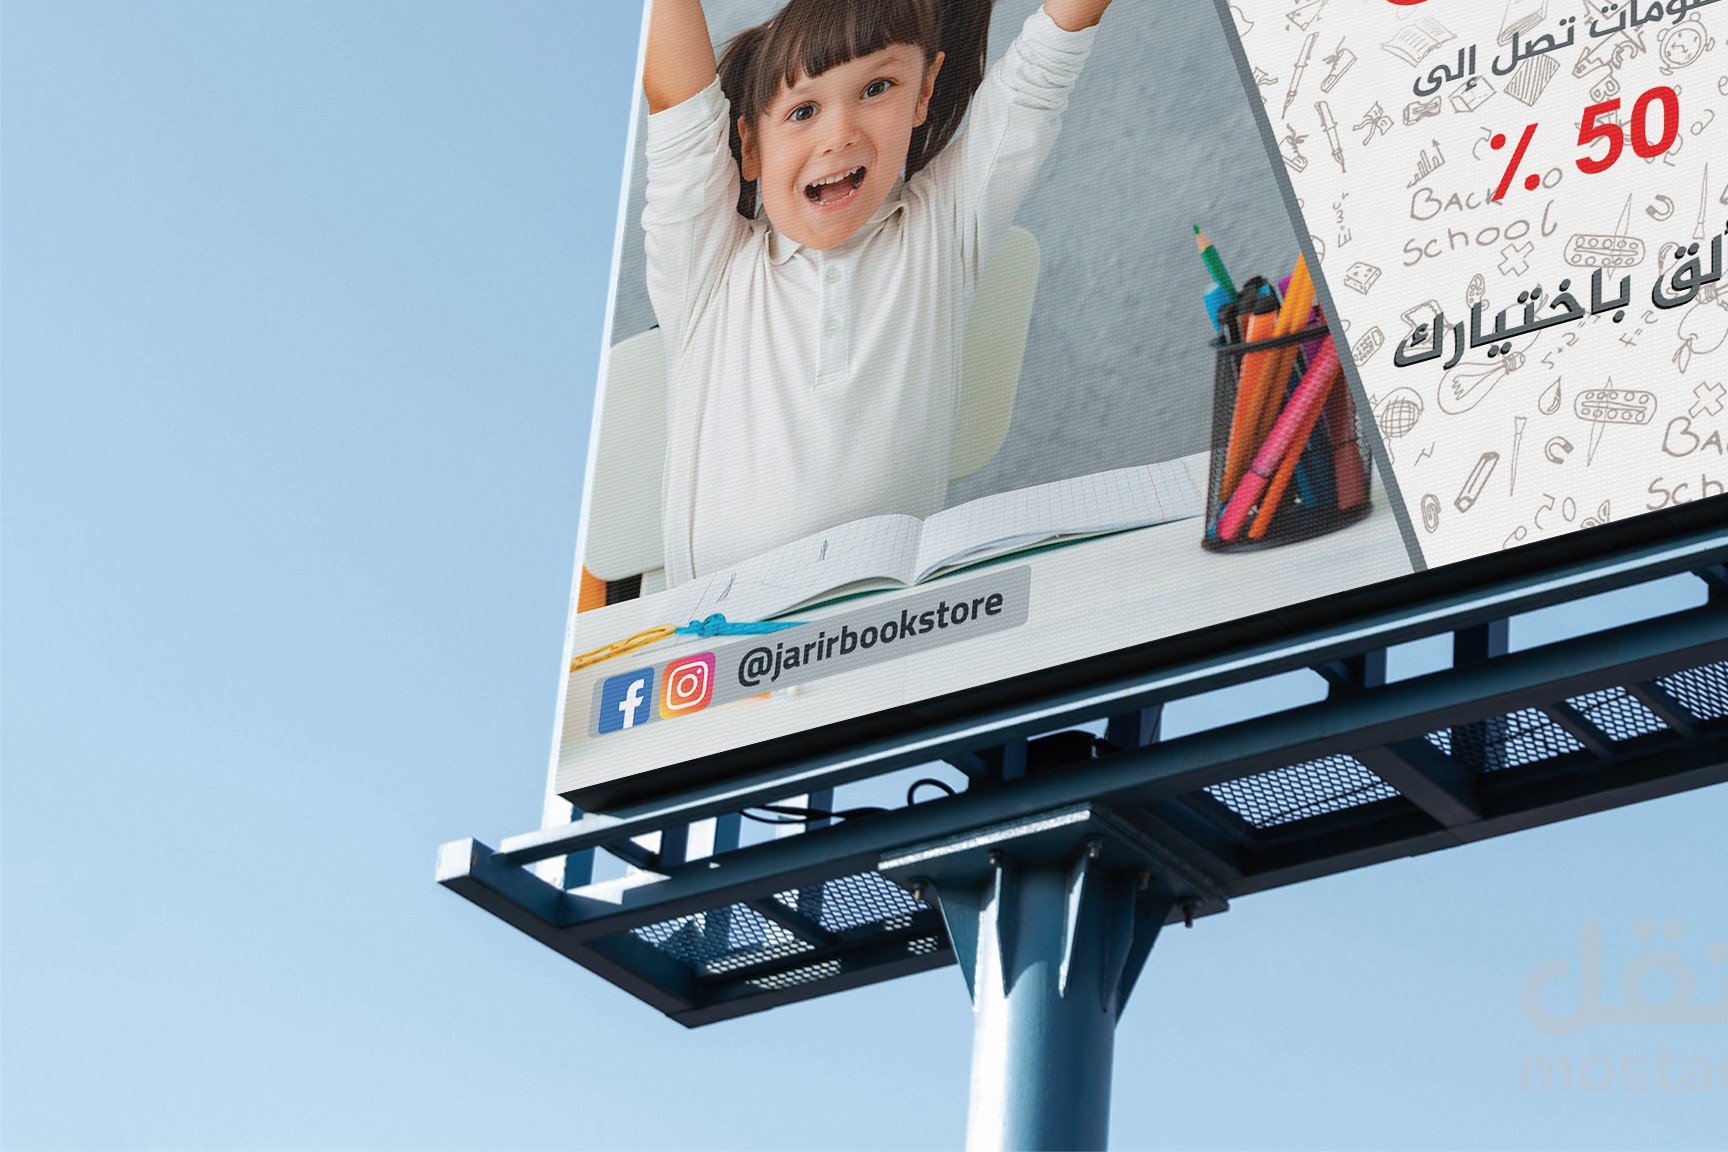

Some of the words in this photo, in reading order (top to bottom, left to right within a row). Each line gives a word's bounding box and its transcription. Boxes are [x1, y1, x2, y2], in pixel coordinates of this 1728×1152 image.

[1413, 44, 1477, 97] إلى
[1491, 16, 1576, 76] تصل
[1575, 86, 1680, 175] 50
[1394, 267, 1631, 371] باختيارك
[738, 592, 1004, 688] @jarirbookstore
